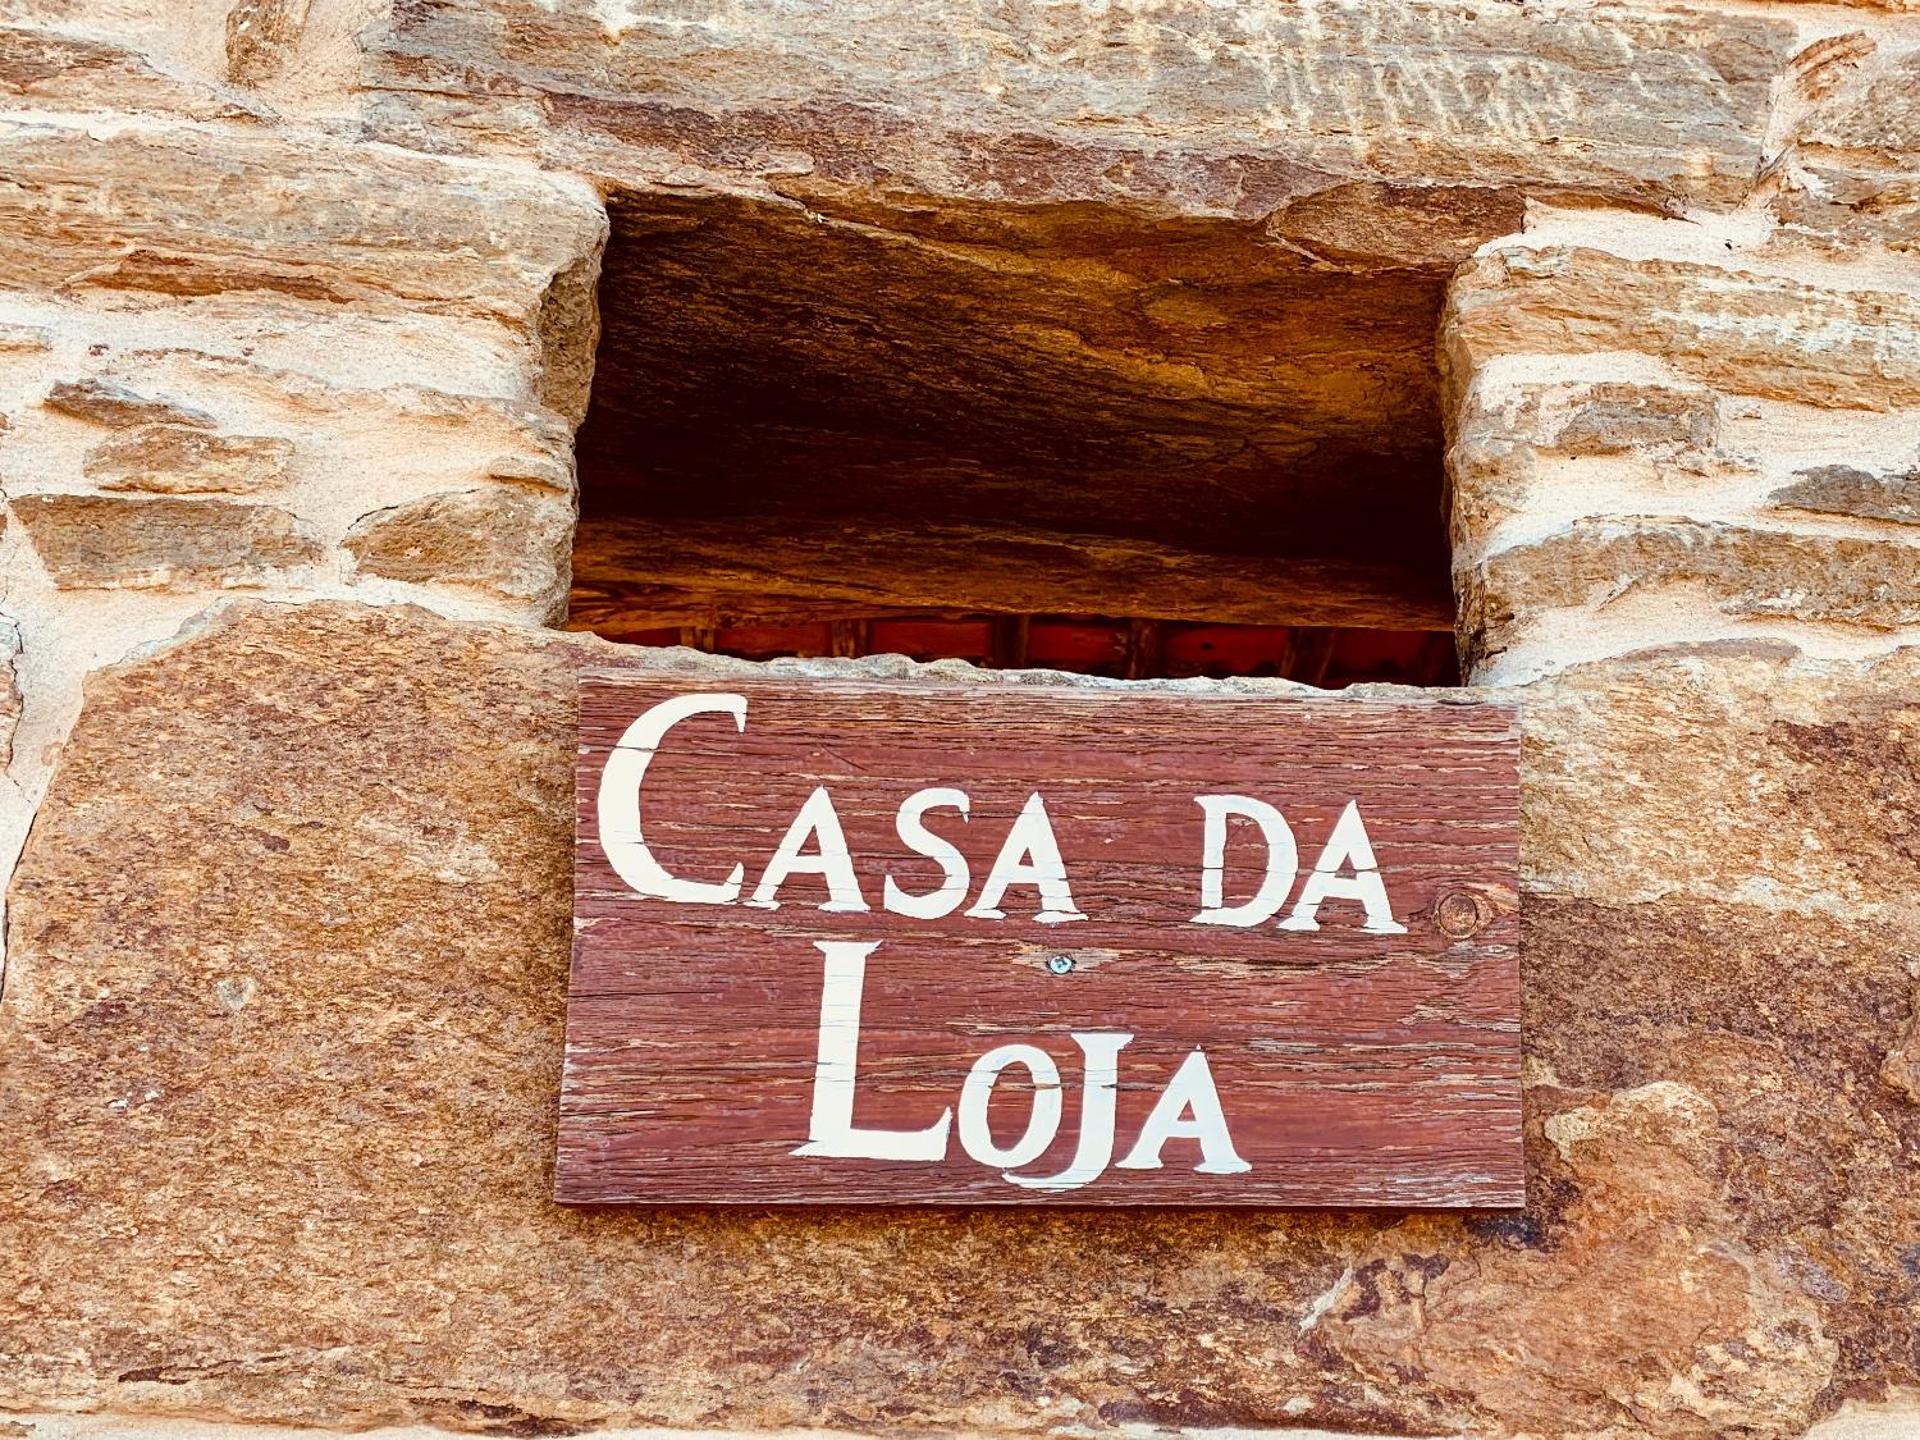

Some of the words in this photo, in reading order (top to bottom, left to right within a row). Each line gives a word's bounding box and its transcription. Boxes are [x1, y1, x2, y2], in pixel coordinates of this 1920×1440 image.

[596, 692, 1088, 922] CASA
[1190, 795, 1408, 935] DA
[790, 939, 1253, 1190] LOJA
